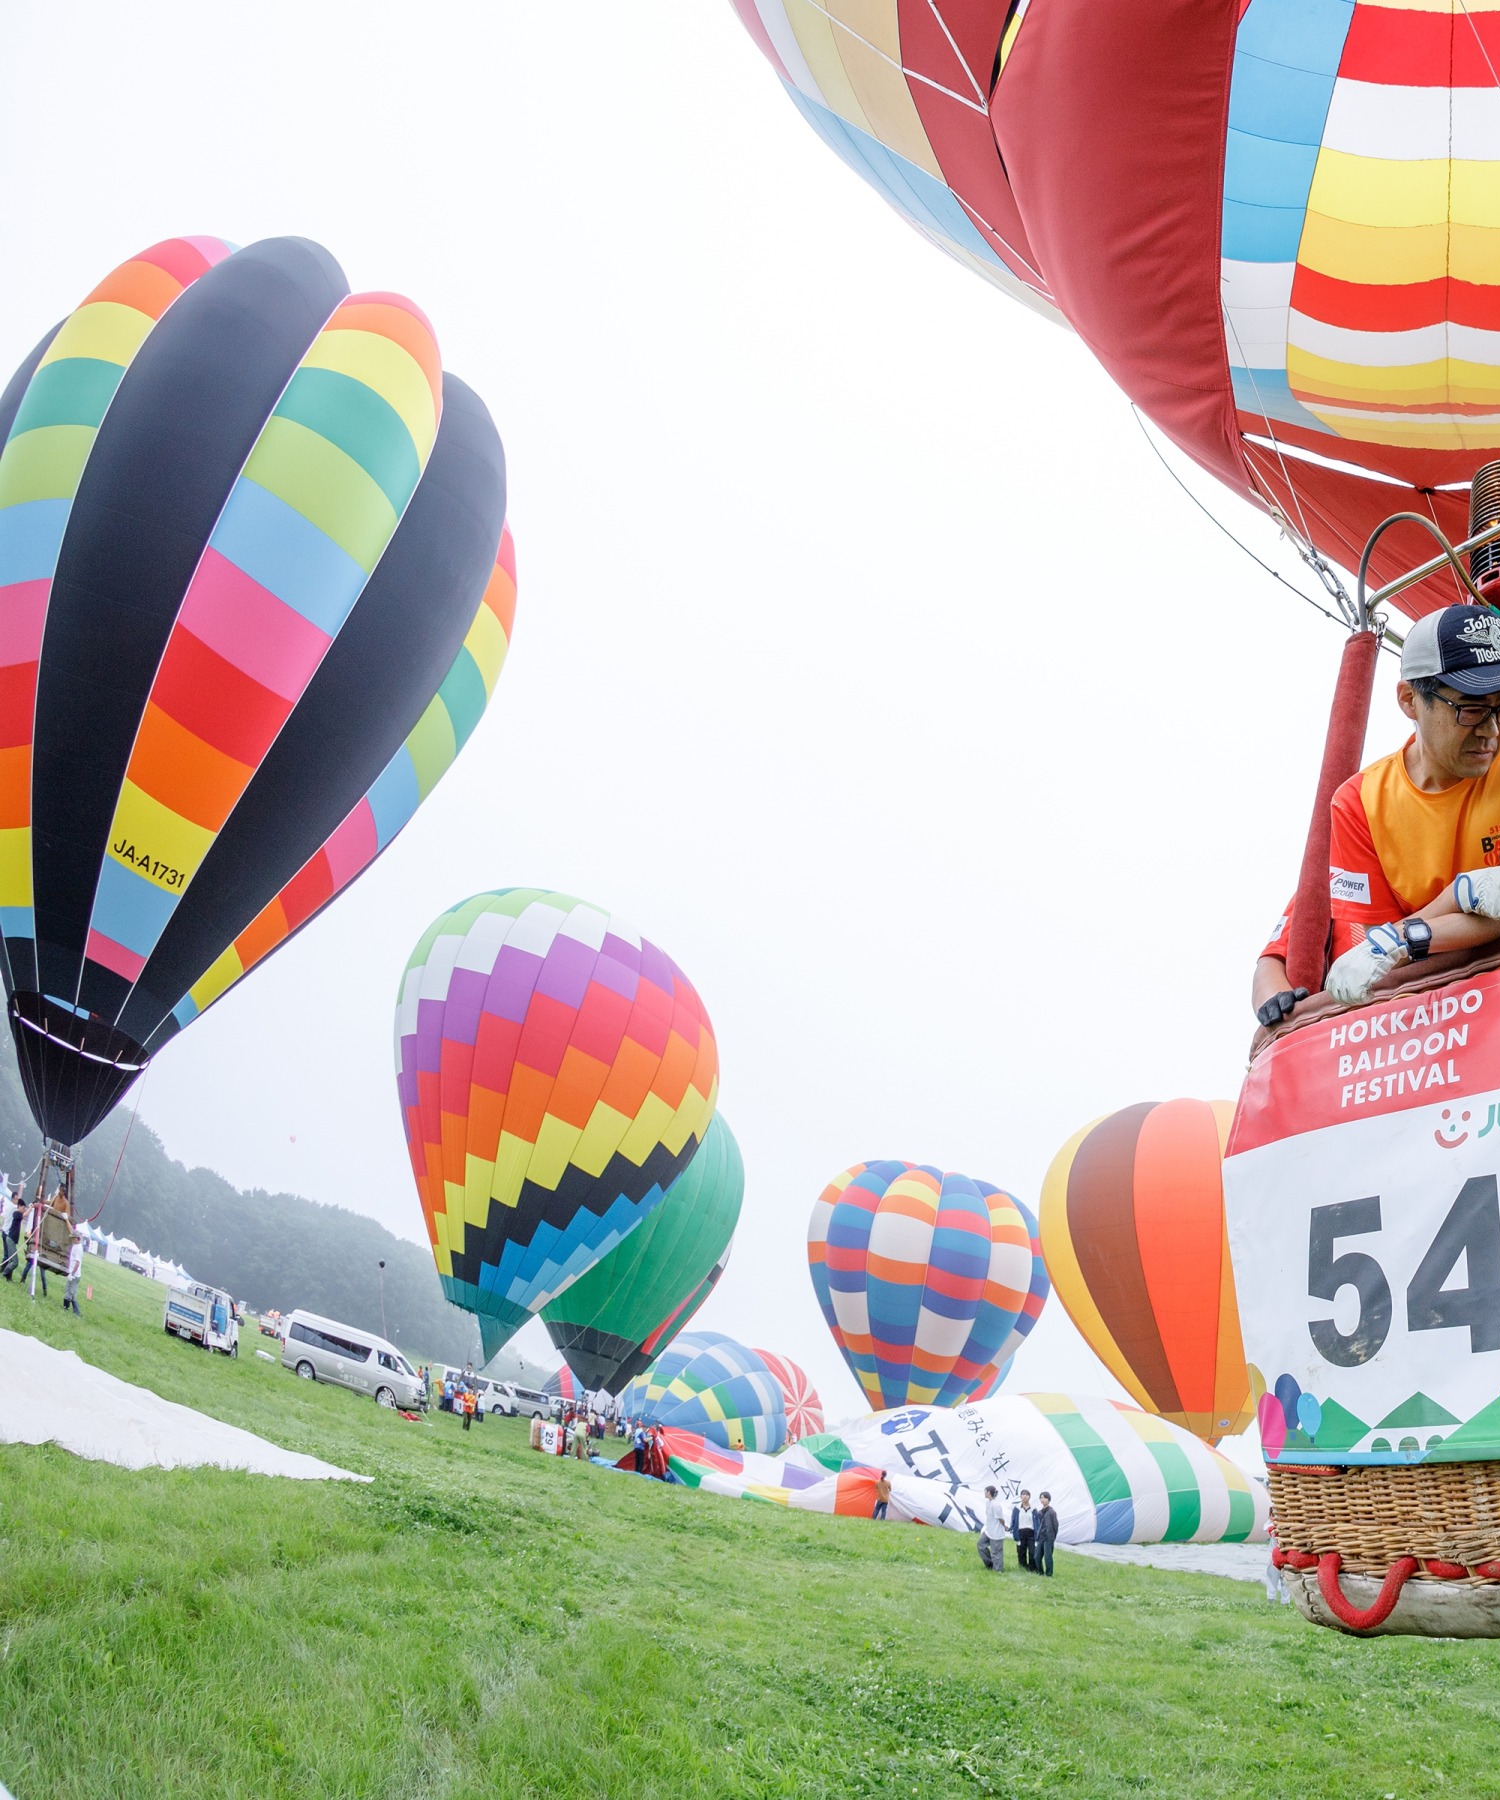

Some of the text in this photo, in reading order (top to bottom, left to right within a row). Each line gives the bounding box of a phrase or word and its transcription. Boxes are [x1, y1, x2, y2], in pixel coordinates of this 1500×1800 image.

[1331, 886, 1354, 898] Group
[1334, 877, 1365, 892] POWER
[1330, 989, 1483, 1050] HOKKAIDO
[1338, 1024, 1469, 1078] BALLOON
[1340, 1059, 1461, 1108] FESTIVAL
[545, 1431, 554, 1446] 29
